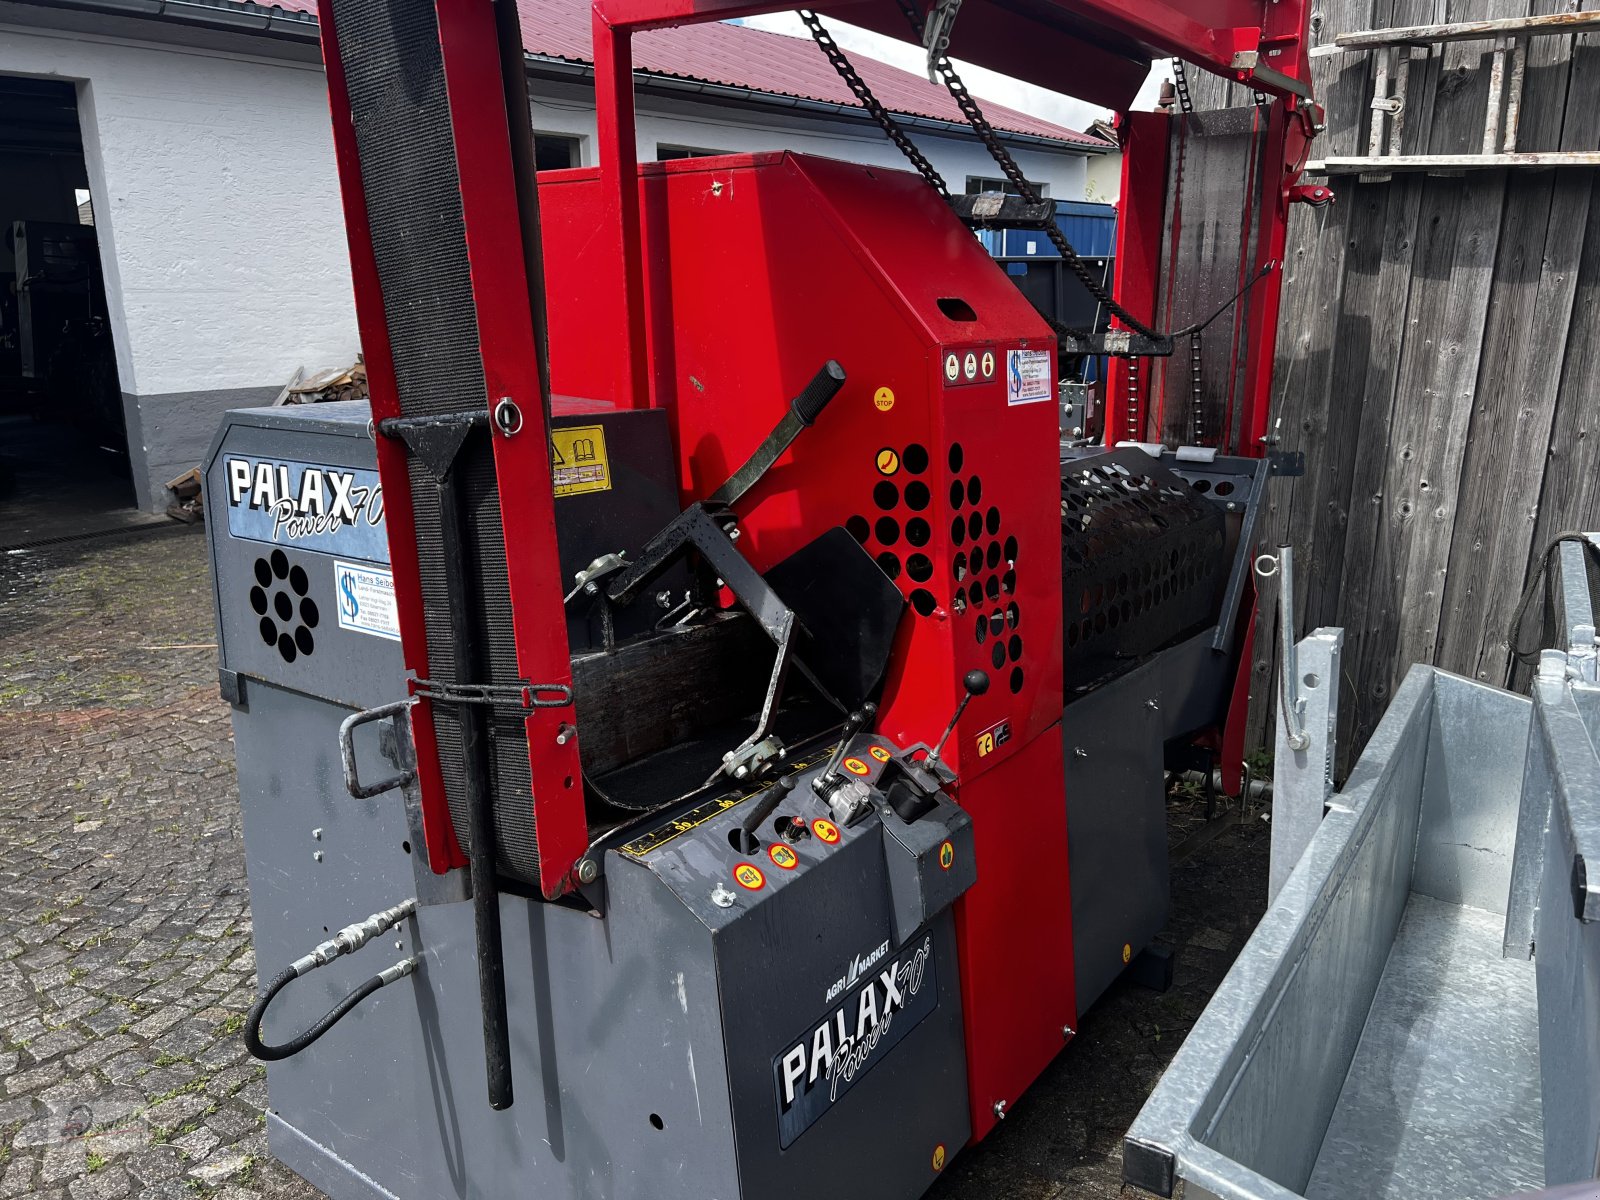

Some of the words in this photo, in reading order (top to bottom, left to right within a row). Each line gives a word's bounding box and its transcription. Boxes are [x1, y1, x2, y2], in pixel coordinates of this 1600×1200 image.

[228, 459, 354, 525] PALAX
[269, 498, 341, 540] Power
[358, 574, 374, 583] Hans
[375, 577, 394, 587] Seibo
[674, 821, 692, 832] 90
[718, 799, 735, 809] 80
[825, 975, 846, 1004] AGRI
[858, 939, 890, 974] MARKET
[781, 959, 904, 1108] PALAX
[825, 1011, 893, 1103] Power
